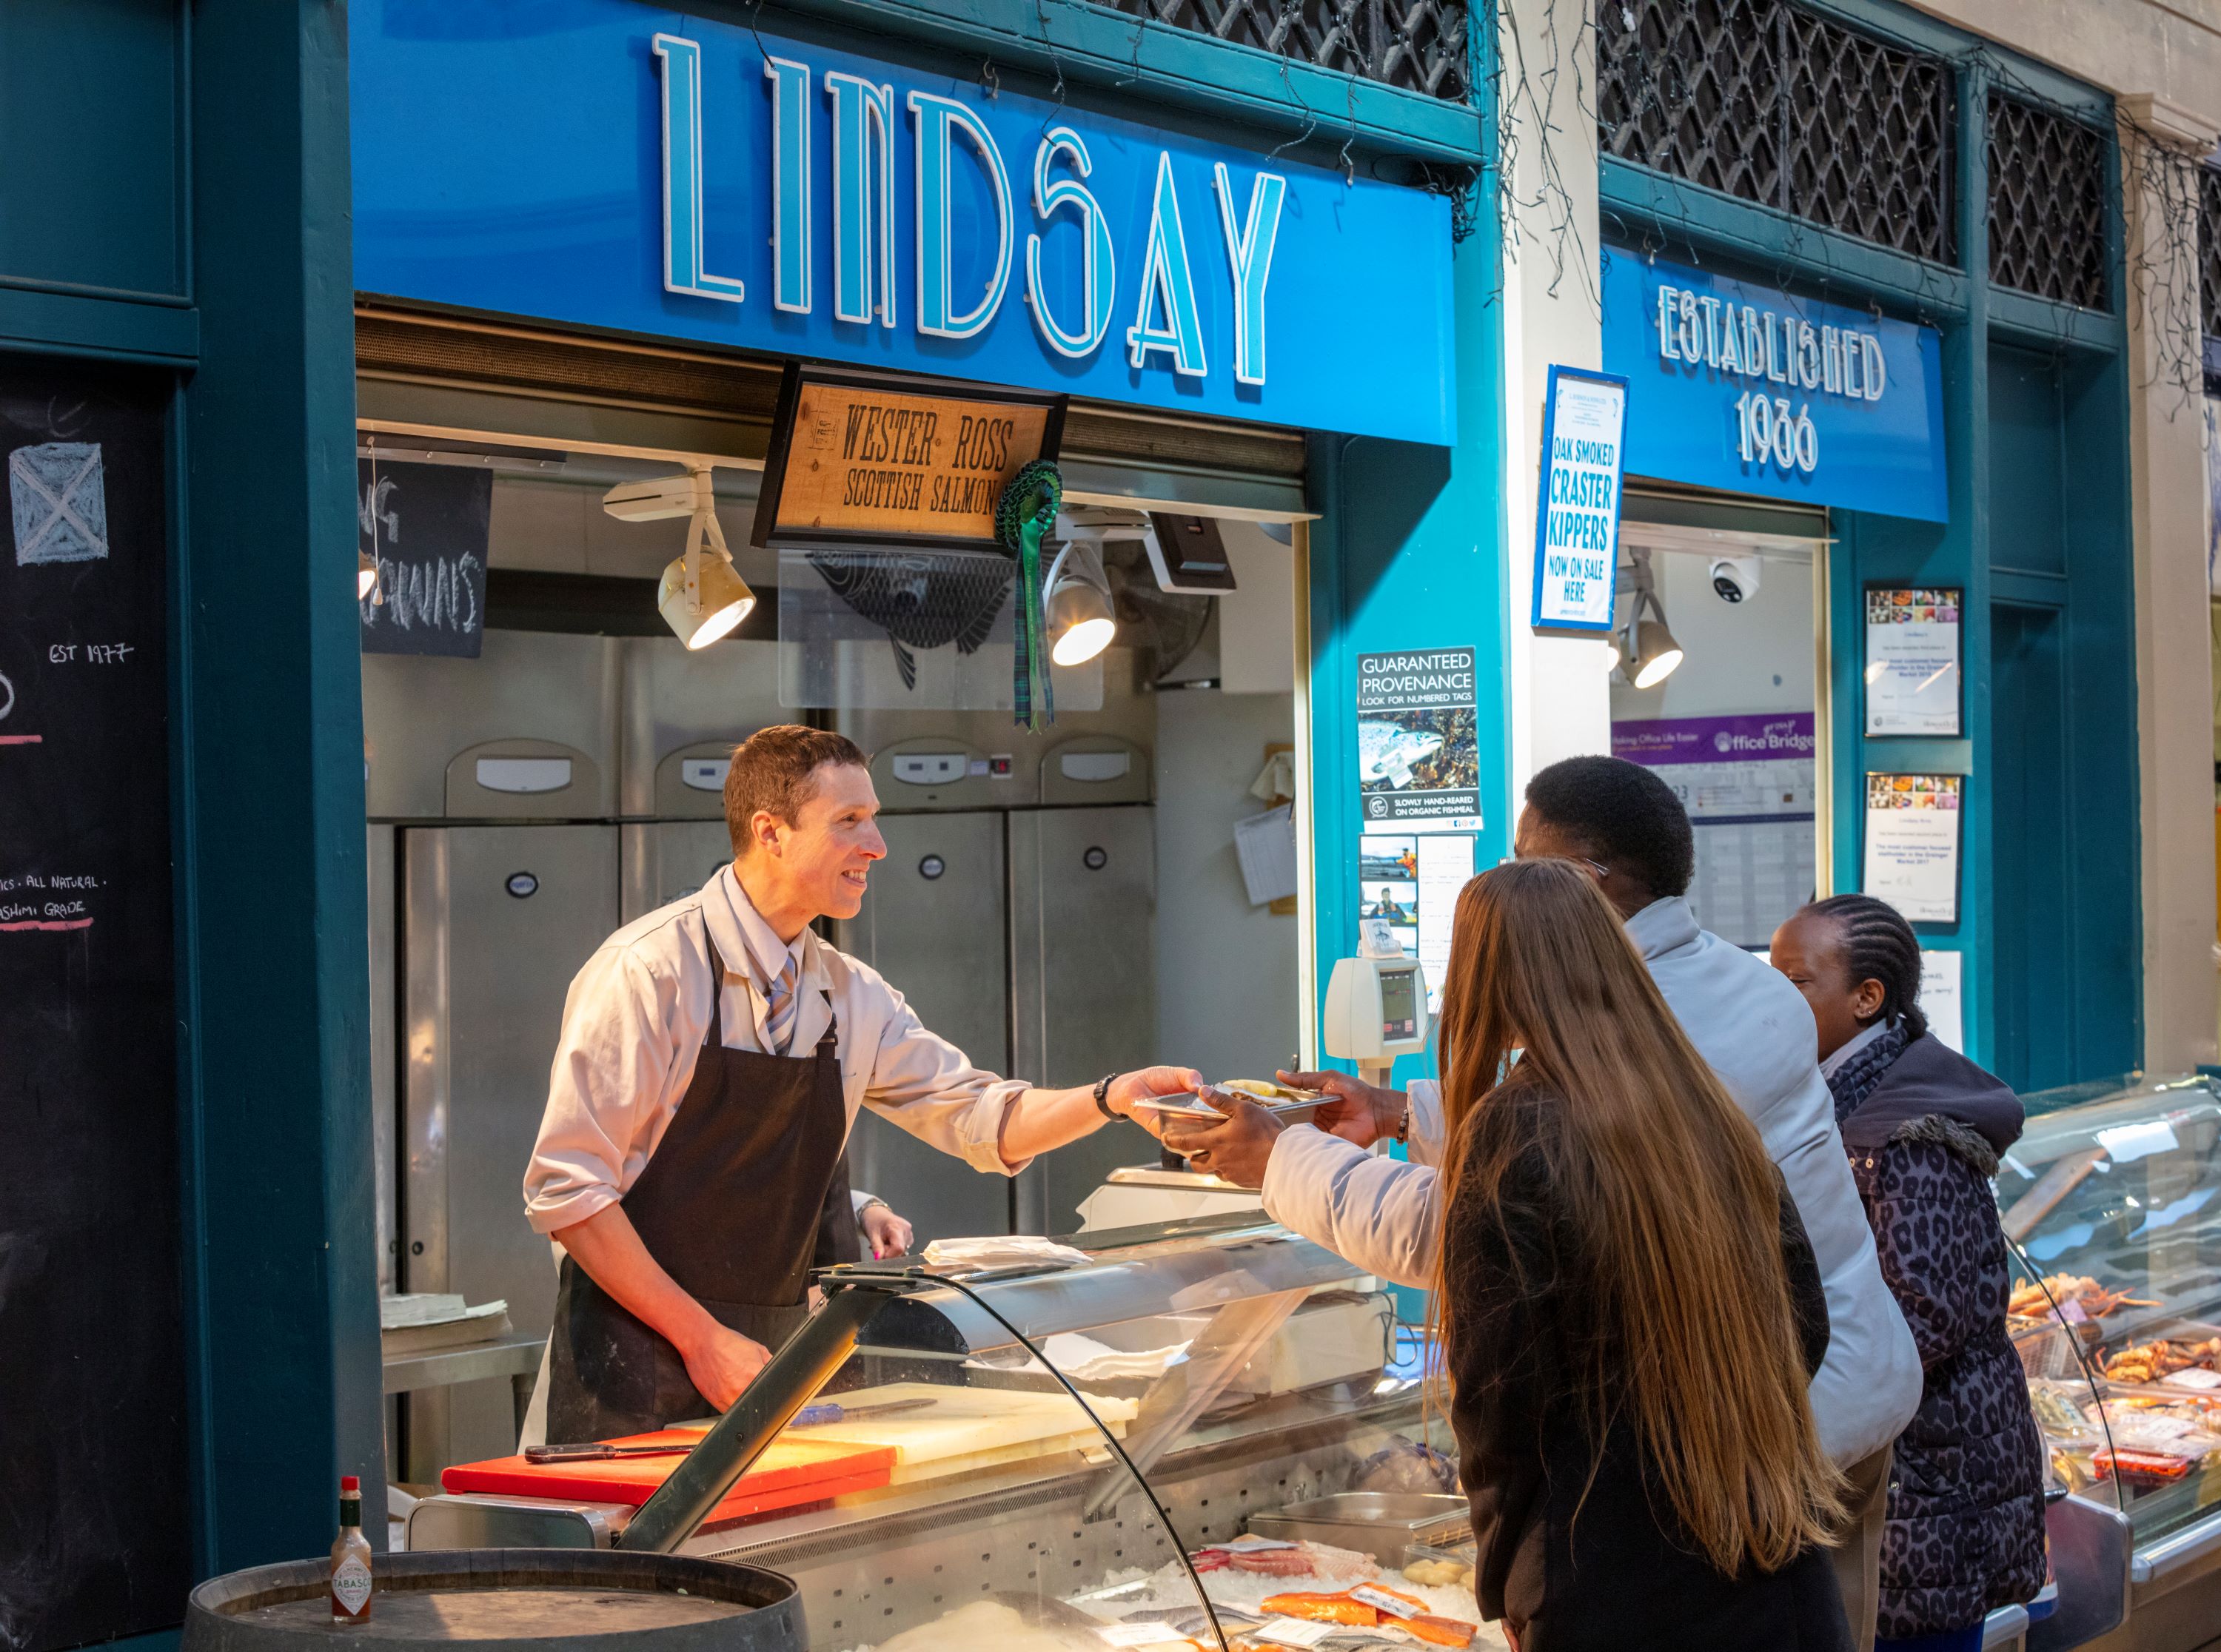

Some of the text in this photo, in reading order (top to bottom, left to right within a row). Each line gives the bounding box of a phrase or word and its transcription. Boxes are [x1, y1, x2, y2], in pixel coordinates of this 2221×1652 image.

[651, 32, 1285, 386] LINDSAY
[1658, 285, 1886, 401] ESTABLISHED
[842, 404, 938, 466] WESTER
[952, 414, 1014, 472] ROSS
[1736, 391, 1818, 472] 1936
[1554, 436, 1615, 467] OAK SMOKED
[843, 468, 999, 516] SCOTTISH SALMON
[1551, 468, 1612, 510] CRASTER
[1549, 511, 1608, 551] KIPPERS
[1549, 555, 1604, 580] NOW ON SALE
[1564, 580, 1586, 602] HERE
[50, 642, 135, 664] EST 1977
[1362, 653, 1471, 674] GUARANTEED
[1362, 673, 1472, 694] PROVENANCE
[1362, 692, 1473, 706] LOOK FOR NUMBERED TAGS
[1394, 796, 1474, 807] SLOWLY HAND-REARED
[1408, 807, 1441, 816] ORGANIC
[1442, 806, 1475, 814] FISHMEAL
[26, 875, 46, 888] ALL
[51, 876, 98, 890] NATURAL
[44, 901, 86, 919] GRADE
